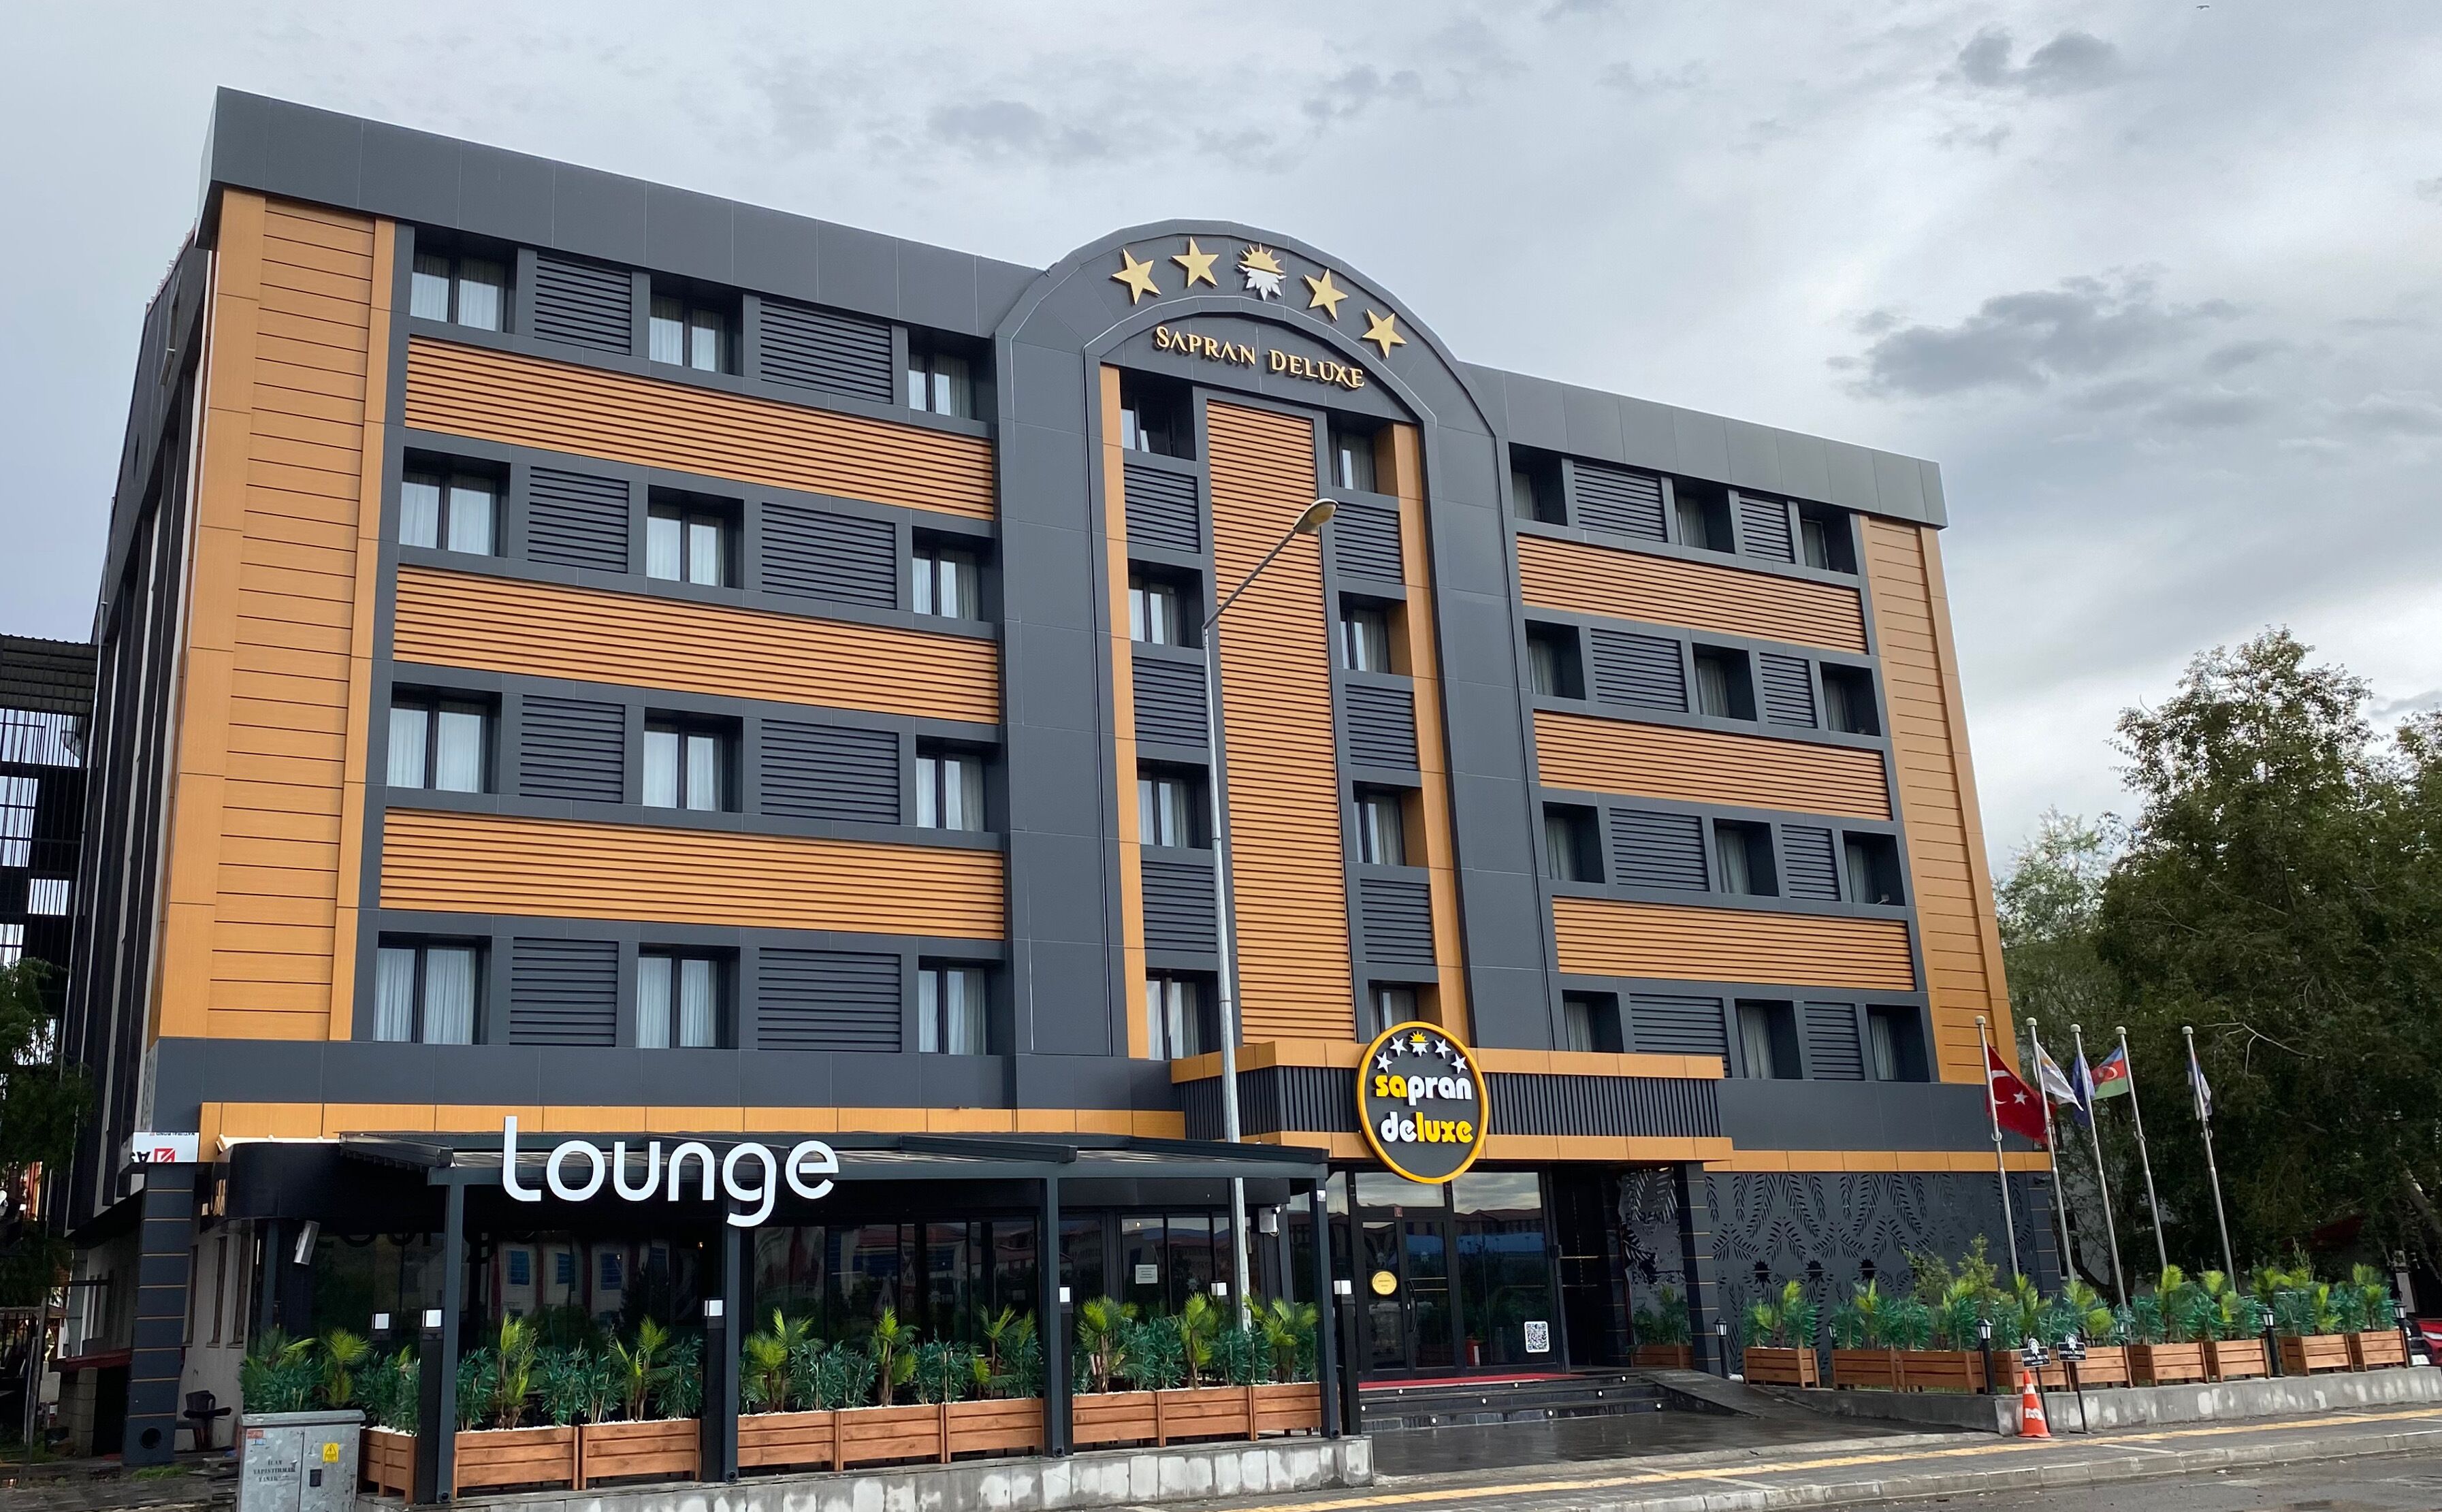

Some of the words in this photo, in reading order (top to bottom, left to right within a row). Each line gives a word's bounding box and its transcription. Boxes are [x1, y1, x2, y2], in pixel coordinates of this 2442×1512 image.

[1156, 326, 1255, 366] SAPRAN
[1269, 349, 1365, 389] DELUXE
[1375, 1075, 1473, 1106] sapran
[1381, 1111, 1474, 1143] deluxe
[502, 1116, 839, 1227] Lounge
